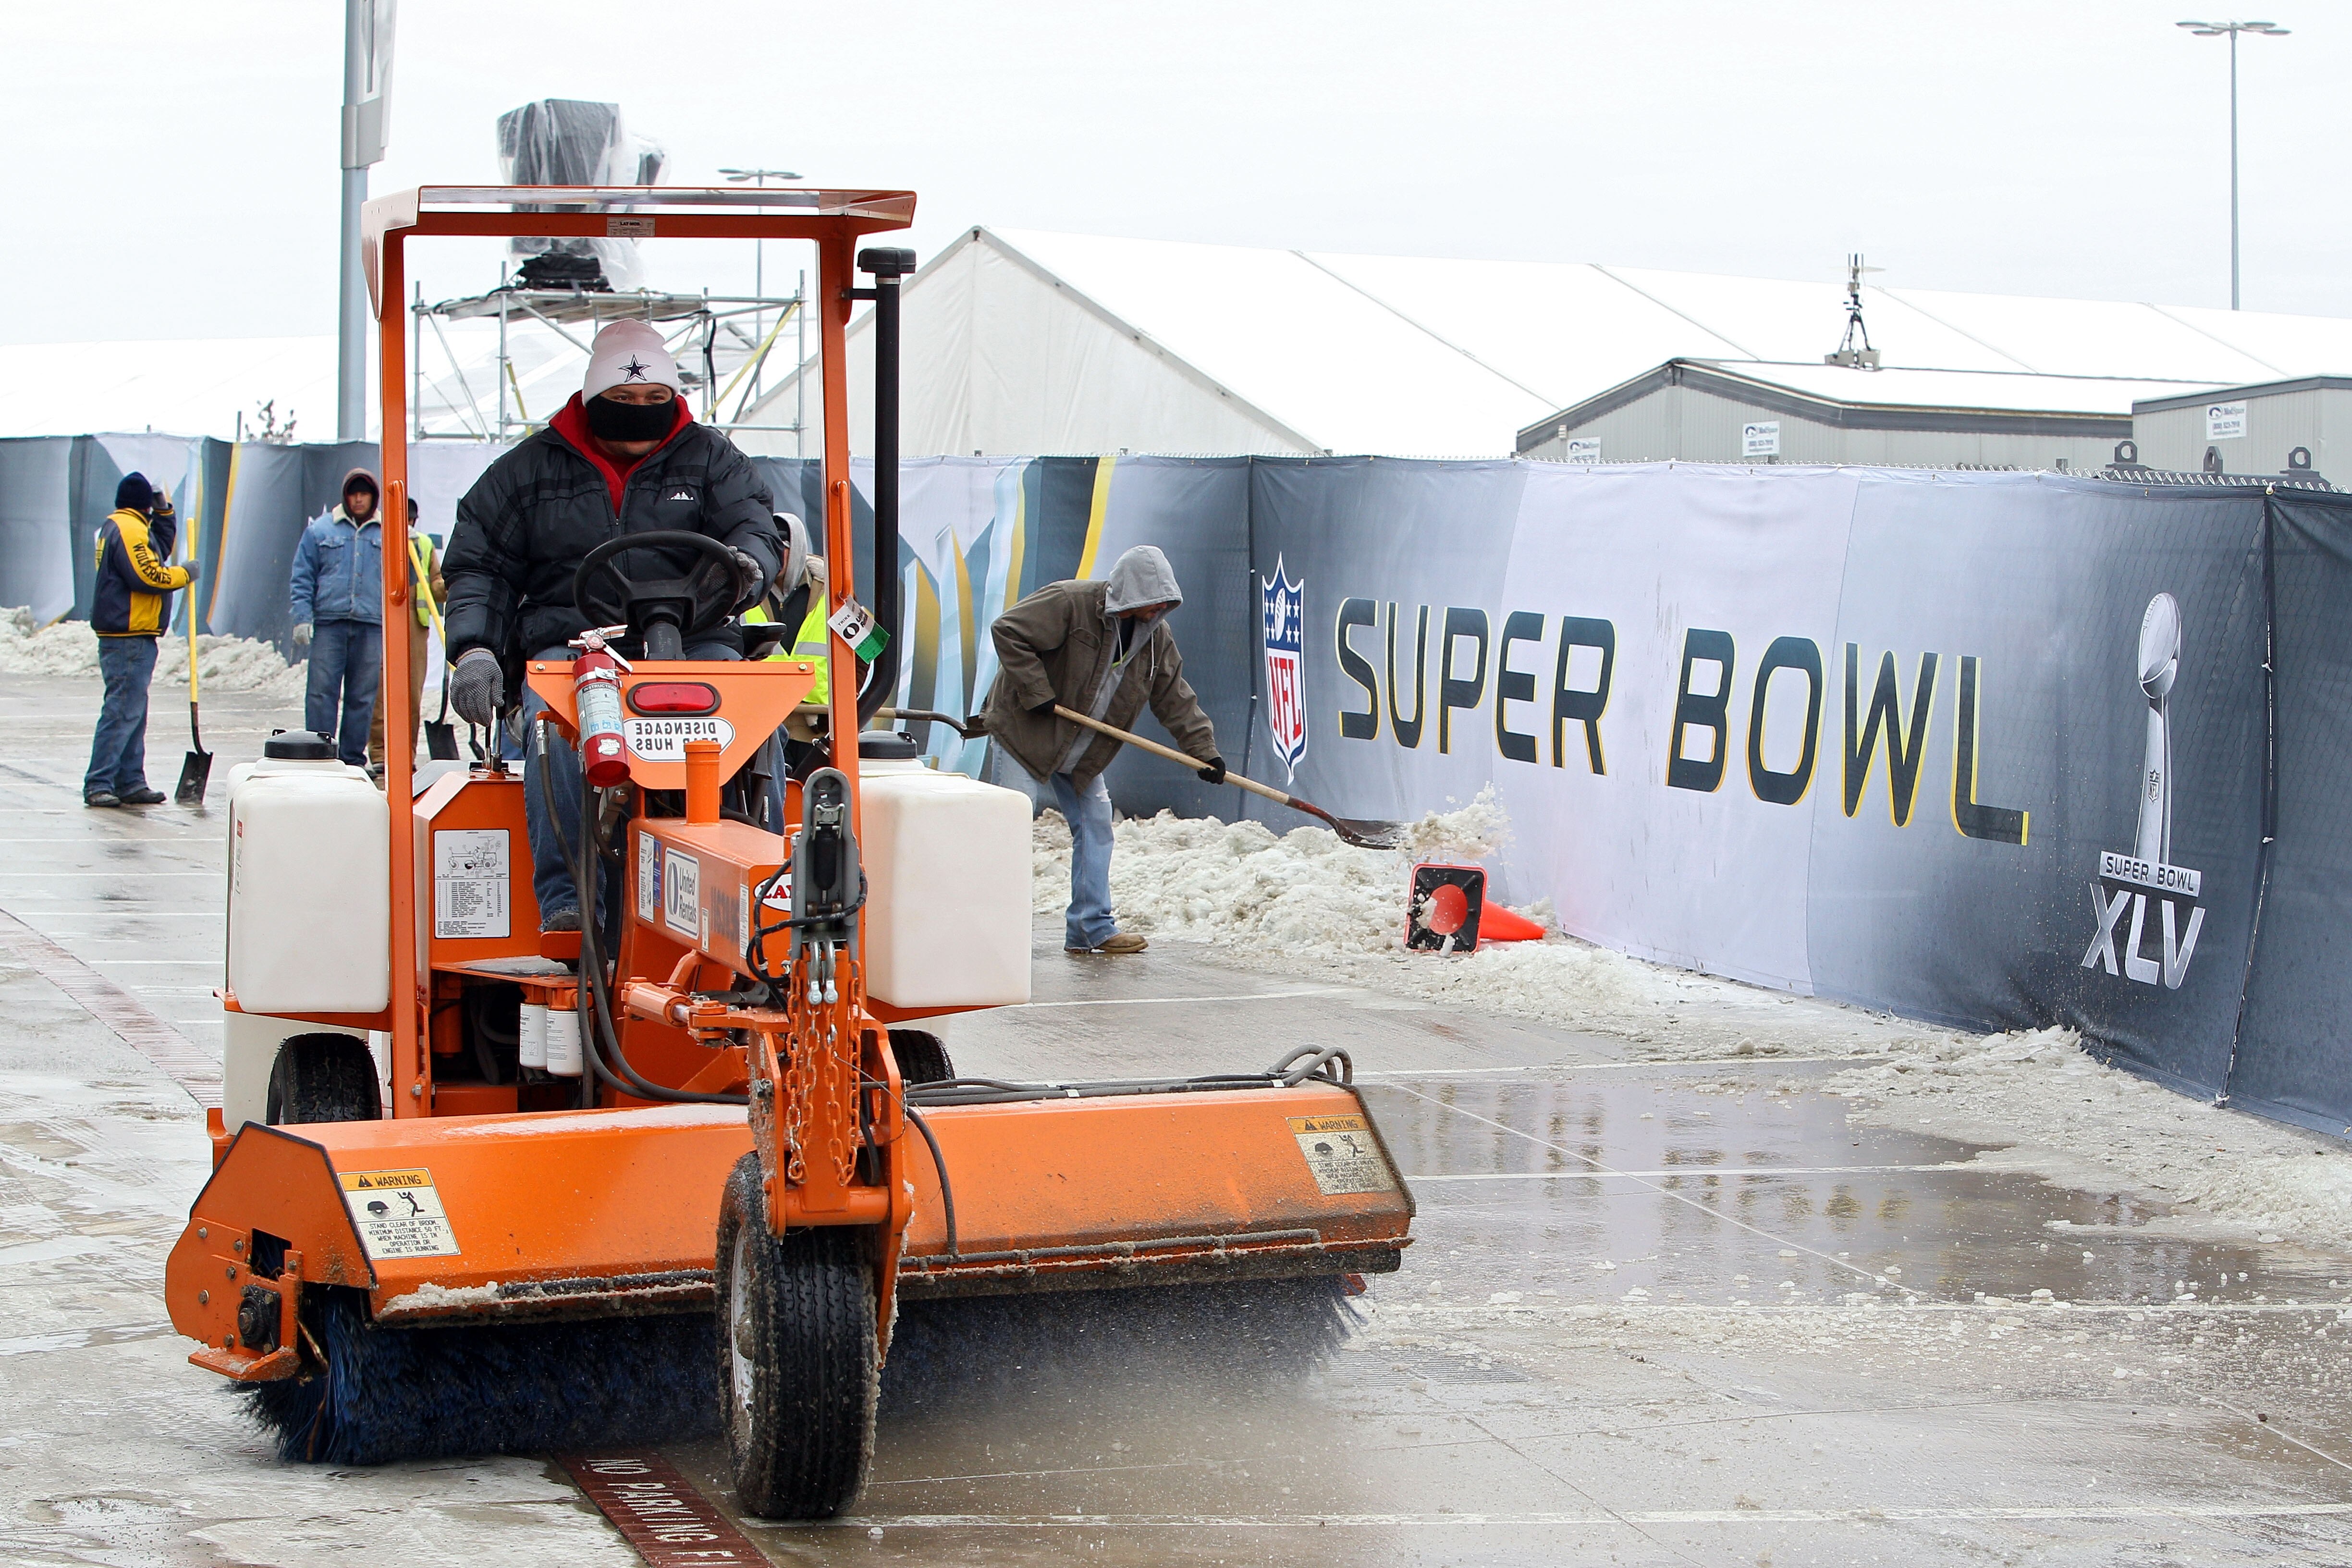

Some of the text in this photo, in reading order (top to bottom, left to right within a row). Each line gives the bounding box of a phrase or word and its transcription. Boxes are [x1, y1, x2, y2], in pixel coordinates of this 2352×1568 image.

[838, 614, 850, 626] THINK
[1268, 656, 1303, 750] NFL
[1335, 598, 2029, 845] SUPER BOWL
[679, 867, 696, 896] United
[2106, 856, 2195, 892] SUPER BOWL
[679, 894, 697, 924] Rentals
[2081, 882, 2206, 990] XLV
[1319, 1119, 1359, 1130] WARNING
[375, 1175, 422, 1186] WARNING
[587, 1459, 652, 1474] NO
[607, 1482, 720, 1543] PARKING
